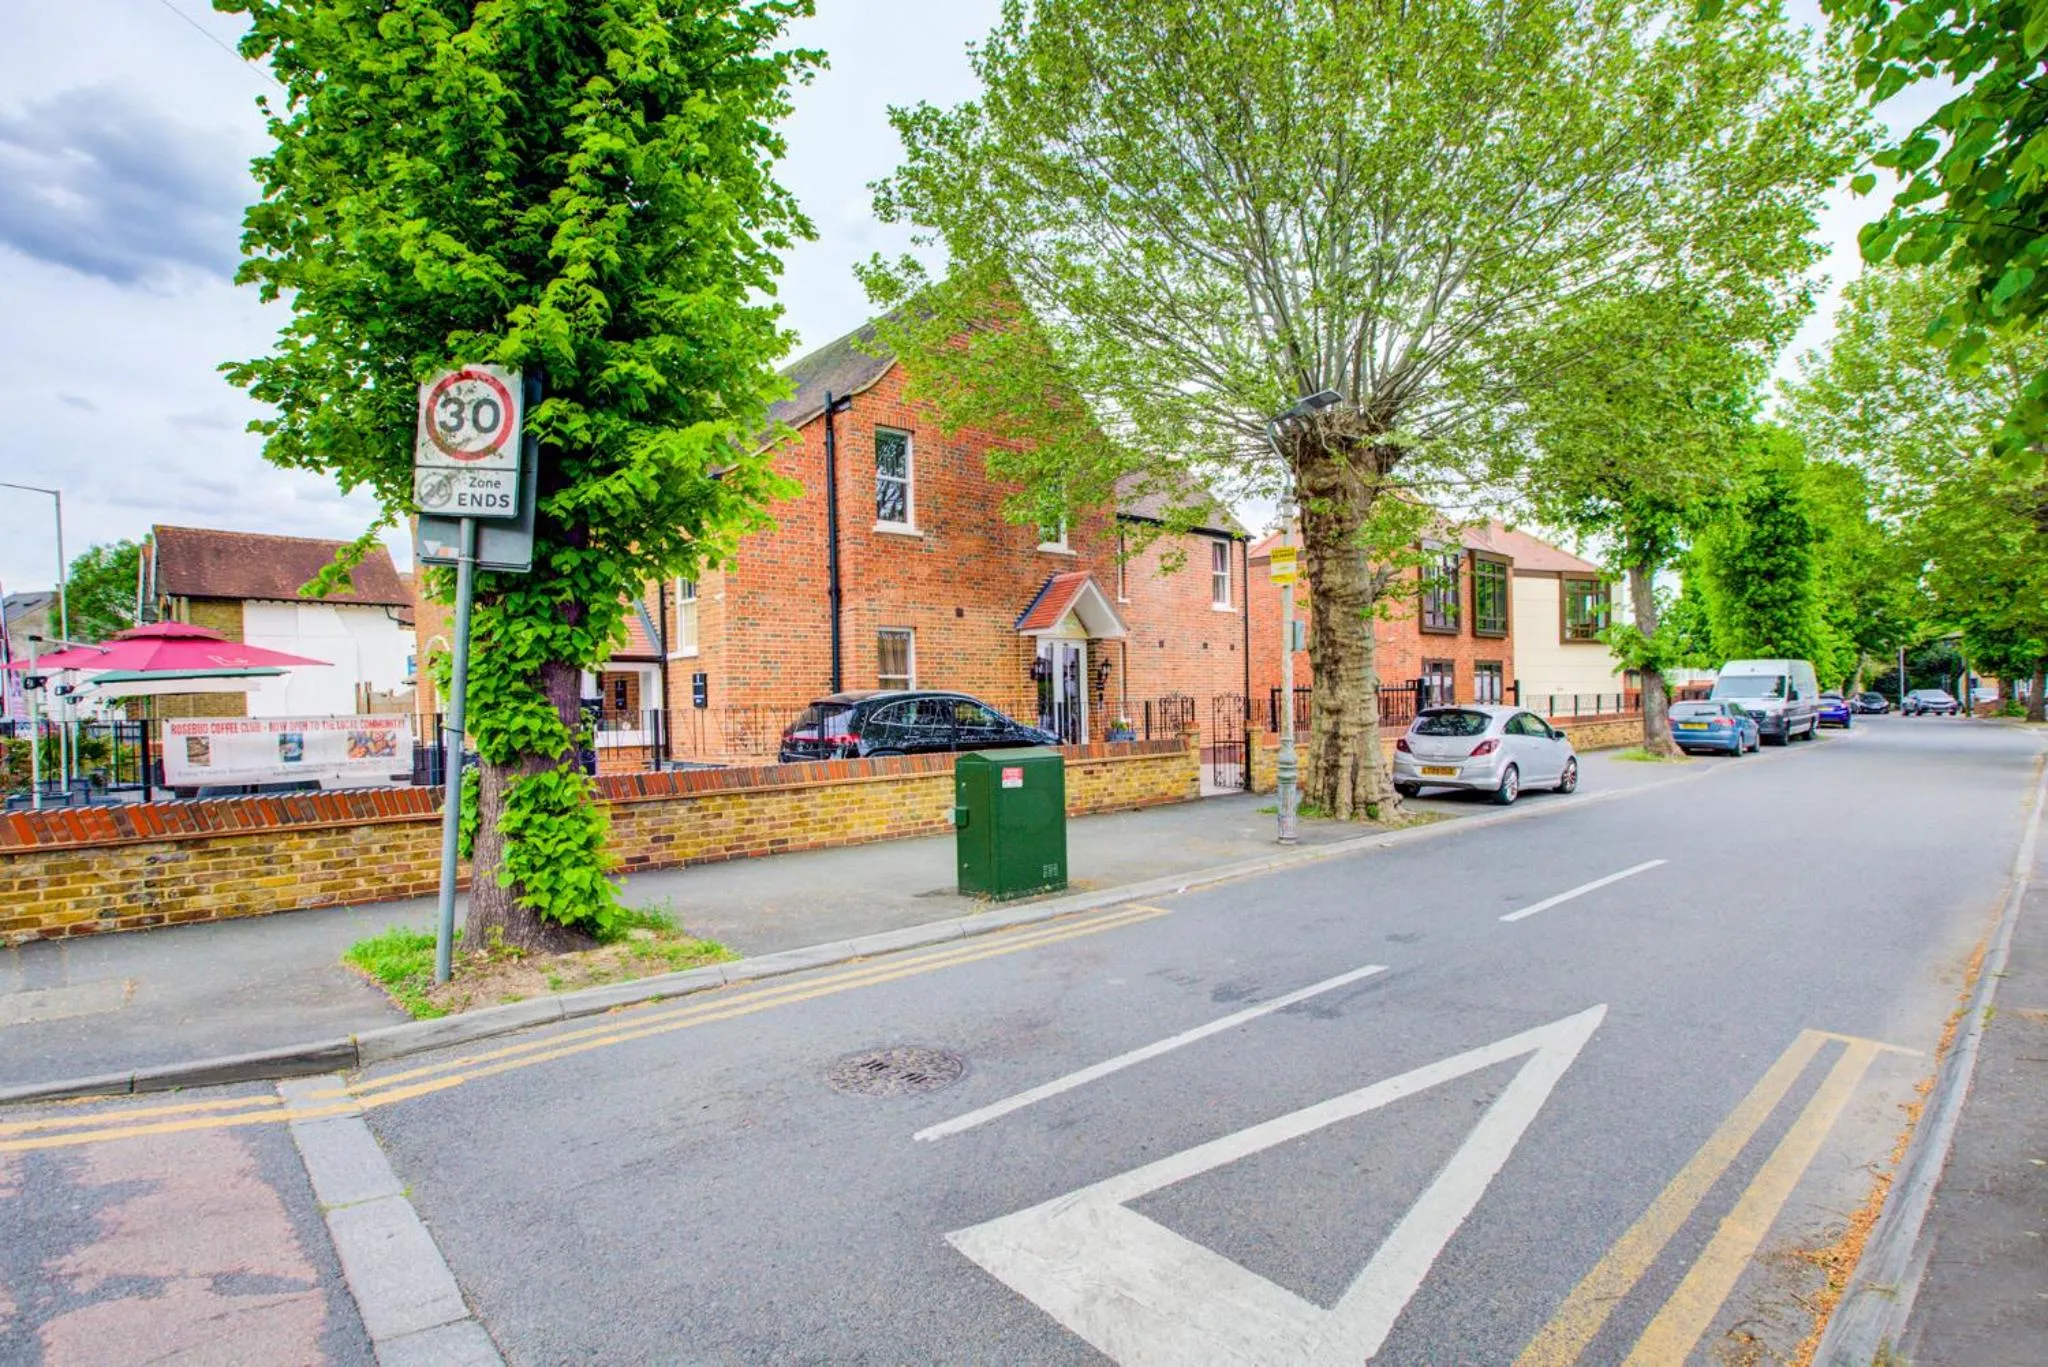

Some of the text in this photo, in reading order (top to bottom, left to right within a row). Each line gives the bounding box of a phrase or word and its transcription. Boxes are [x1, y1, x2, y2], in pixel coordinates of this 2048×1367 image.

[439, 397, 500, 434] 30
[469, 476, 501, 489] Zone
[458, 493, 510, 508] ENDS
[210, 722, 238, 734] COFFEE
